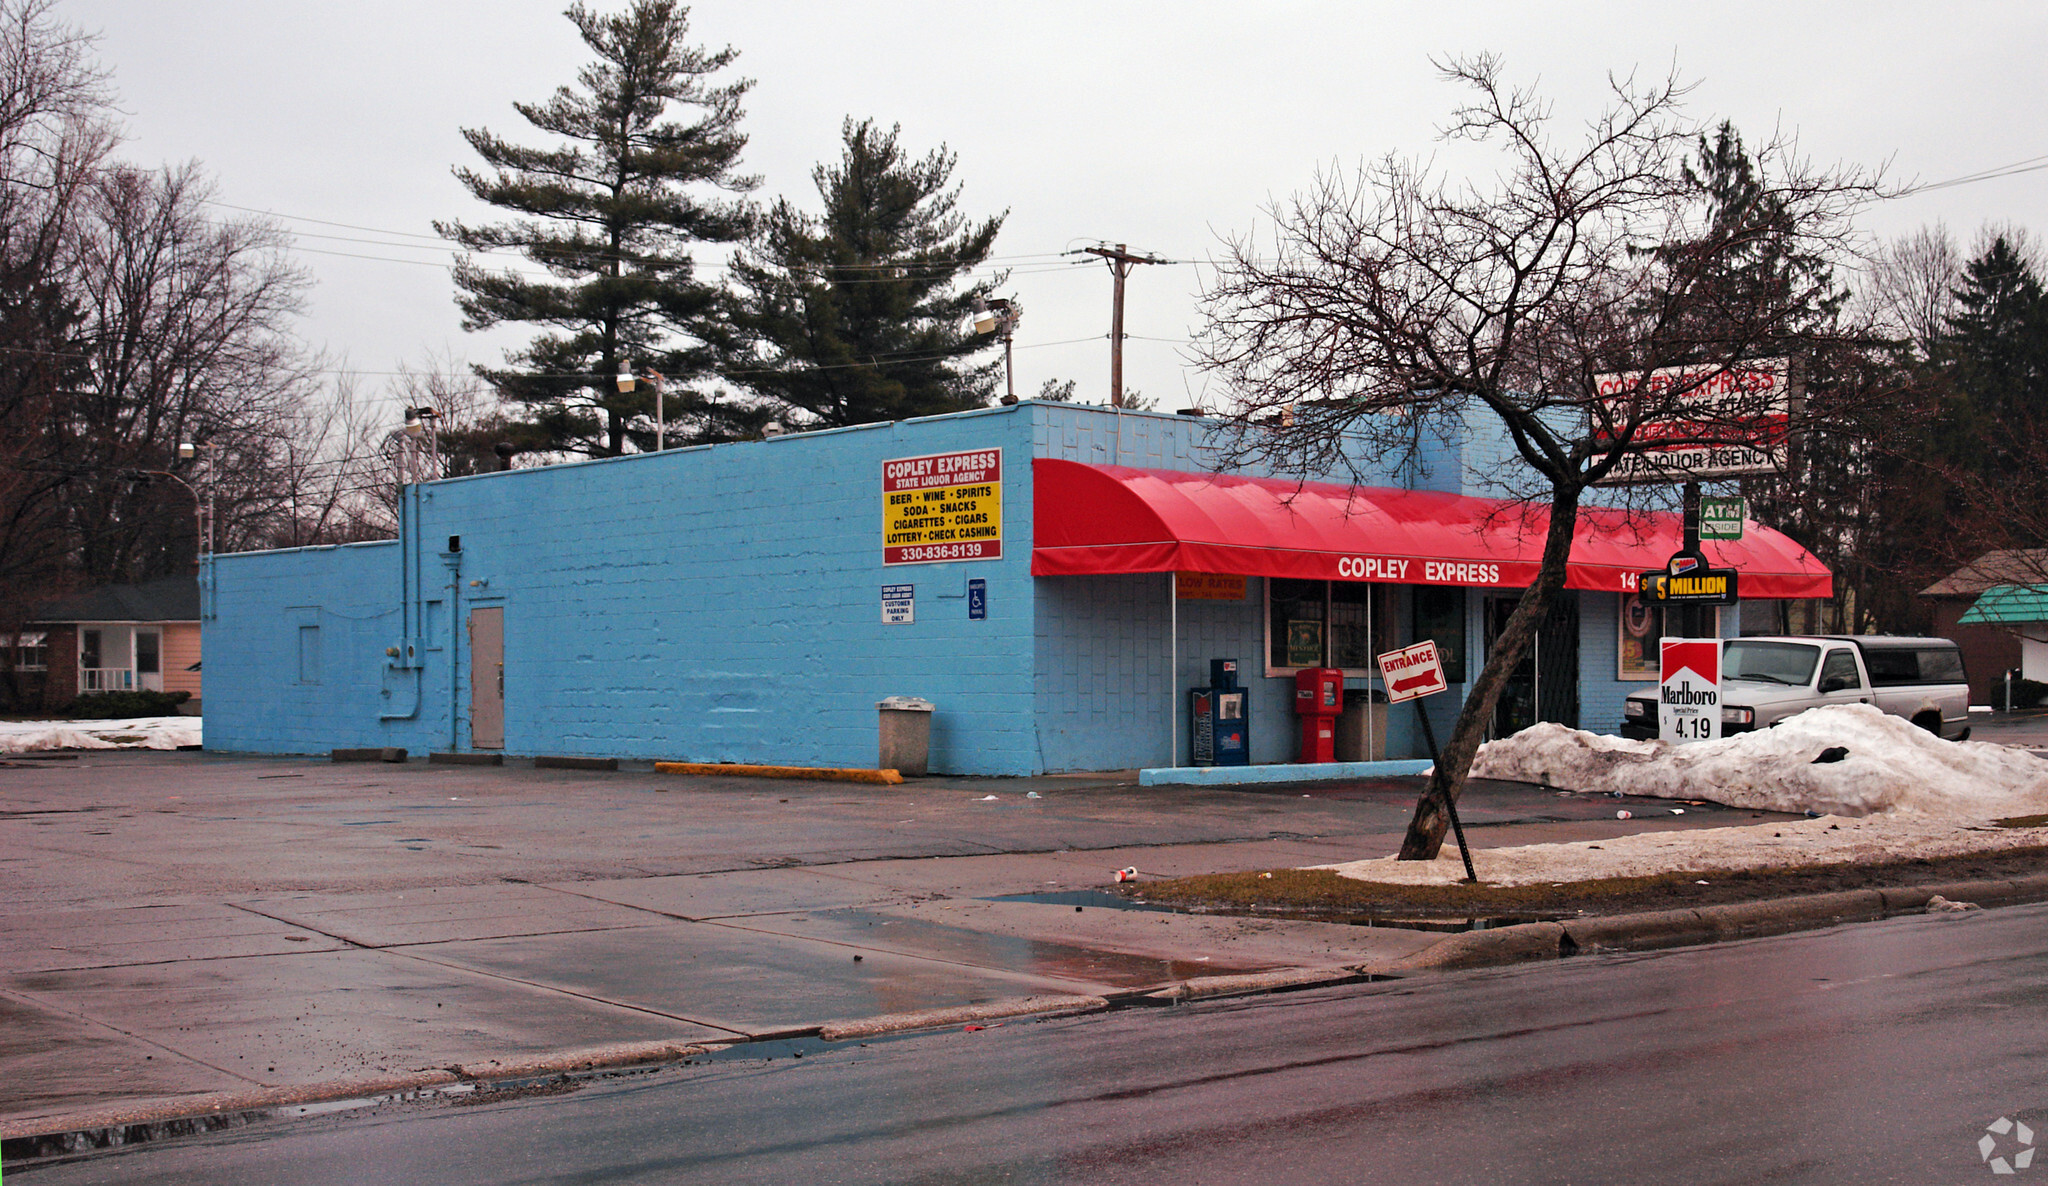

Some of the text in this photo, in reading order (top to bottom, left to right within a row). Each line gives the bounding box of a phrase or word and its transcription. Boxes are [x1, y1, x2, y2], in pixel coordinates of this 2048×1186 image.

[1600, 375, 1675, 404] COPEY
[887, 452, 996, 479] COPLEY EXPRESS
[1647, 453, 1704, 471] LIQUOR
[896, 470, 986, 489] STATE LIQUOR AGENCY
[890, 486, 991, 506] BEER WINE SPIRITS
[903, 500, 977, 517] SODA SNACKS
[1703, 504, 1741, 518] ATM
[893, 513, 988, 530] CIGARETTES CIGARS
[887, 526, 997, 544] LOTTERY CHECK CASHING
[901, 543, 982, 561] 330-836-8139
[1337, 556, 1500, 584] COPLEY EXPRESS
[1179, 577, 1243, 589] LOW RATES
[1620, 571, 1640, 589] 14
[1641, 576, 1727, 600] $ 5 MILLION
[1383, 649, 1434, 673] ENTRANCE
[1660, 680, 1717, 705] Marlboro
[1675, 717, 1711, 739] 4.19
